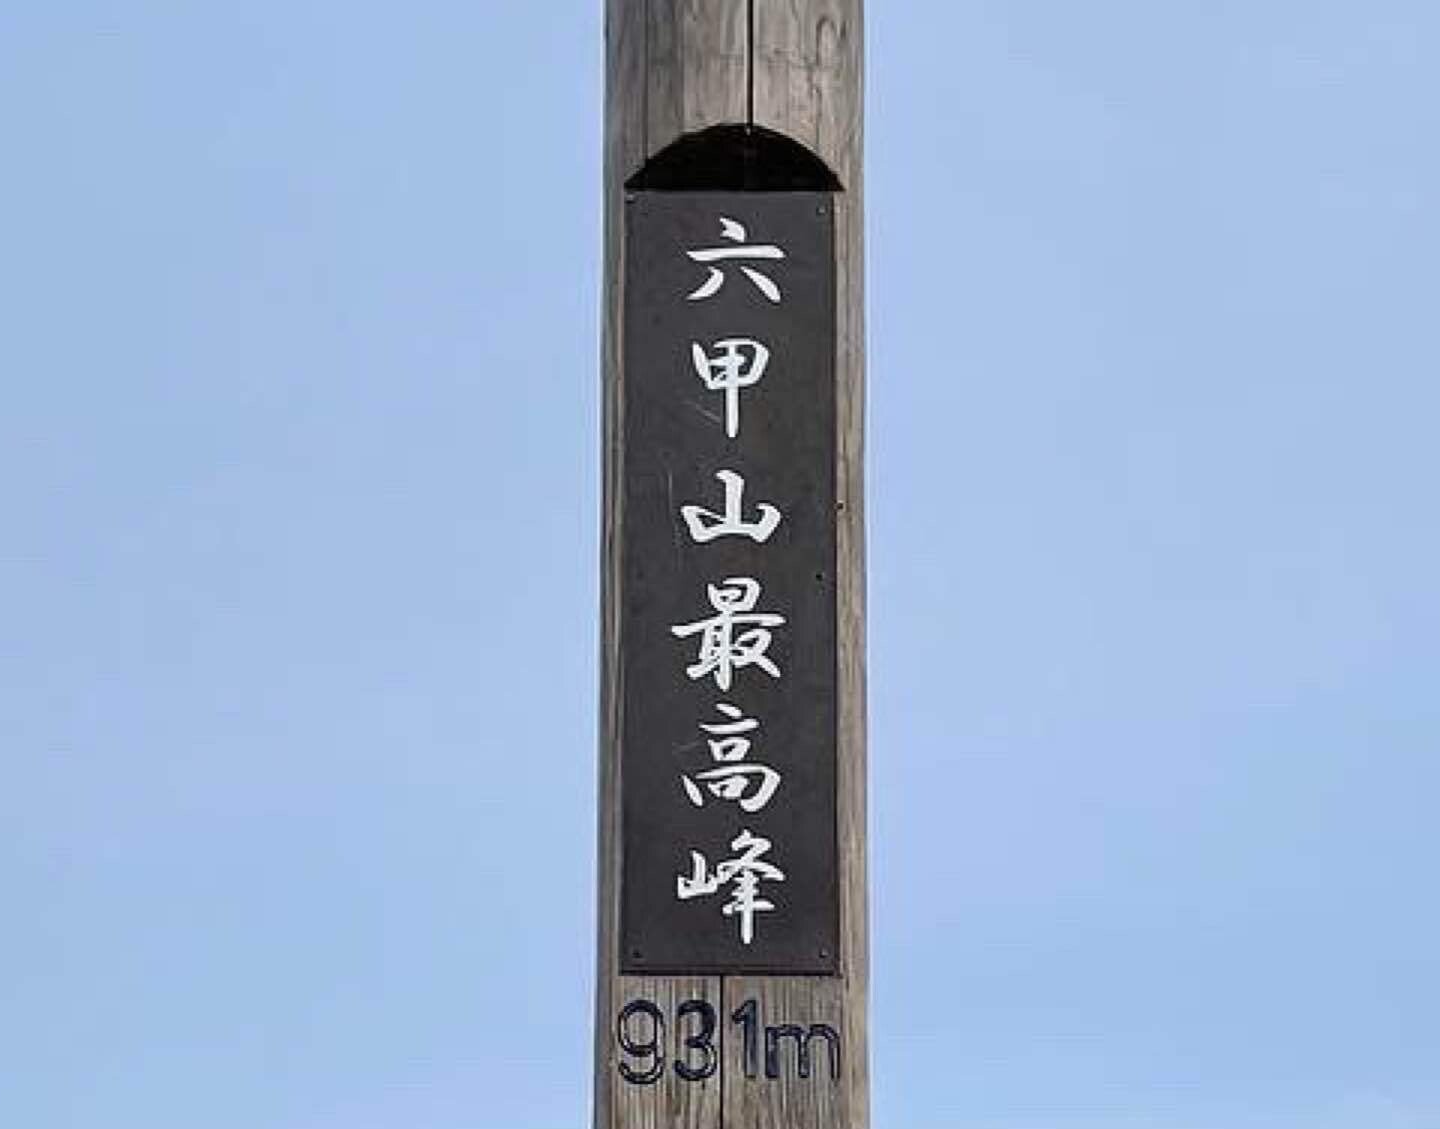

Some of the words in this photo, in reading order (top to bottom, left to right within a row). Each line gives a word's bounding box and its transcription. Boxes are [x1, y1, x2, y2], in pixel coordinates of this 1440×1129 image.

[670, 216, 787, 945] 六甲山最高峰
[617, 999, 841, 1085] 931m
